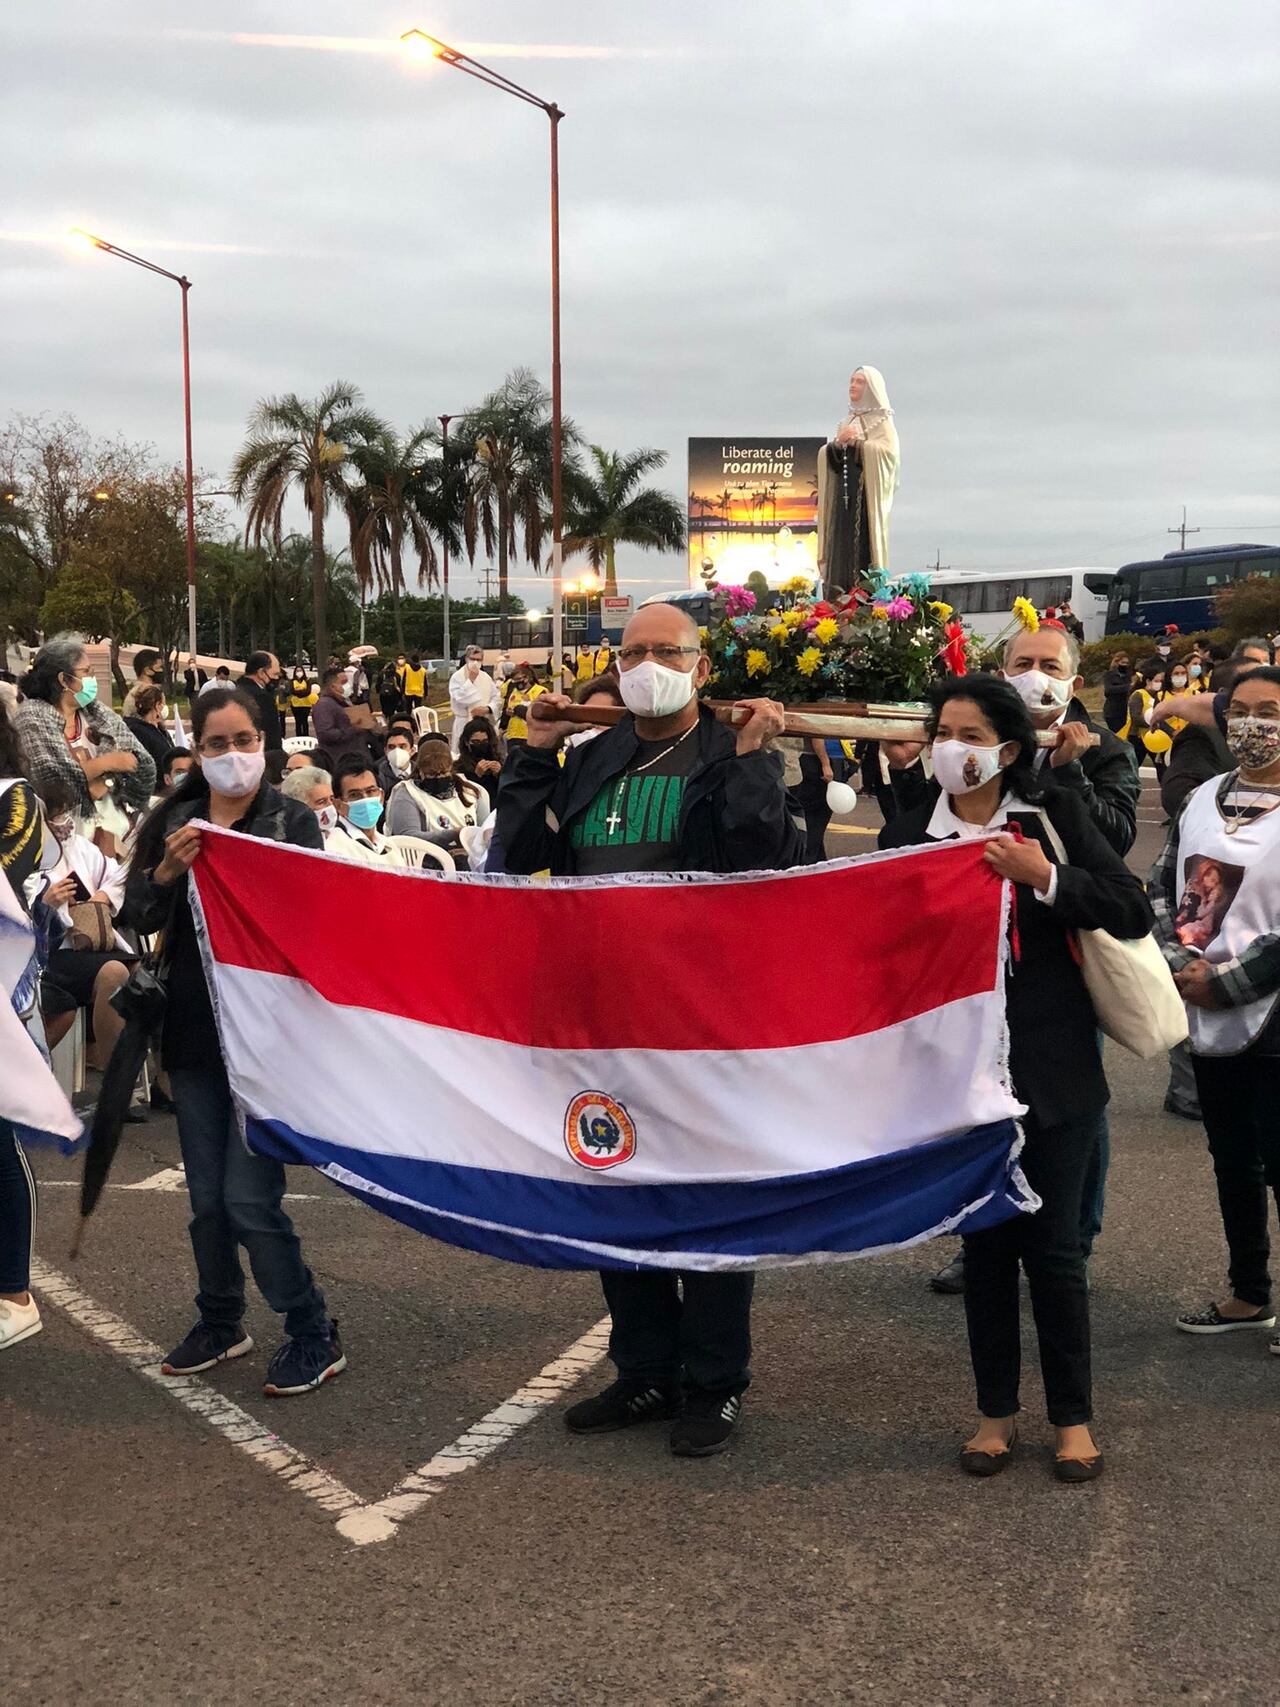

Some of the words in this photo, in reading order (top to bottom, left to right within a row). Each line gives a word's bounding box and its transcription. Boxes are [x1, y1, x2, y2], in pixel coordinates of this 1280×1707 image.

[722, 446, 772, 458] Liberate
[775, 445, 794, 458] del
[722, 458, 794, 478] roaming
